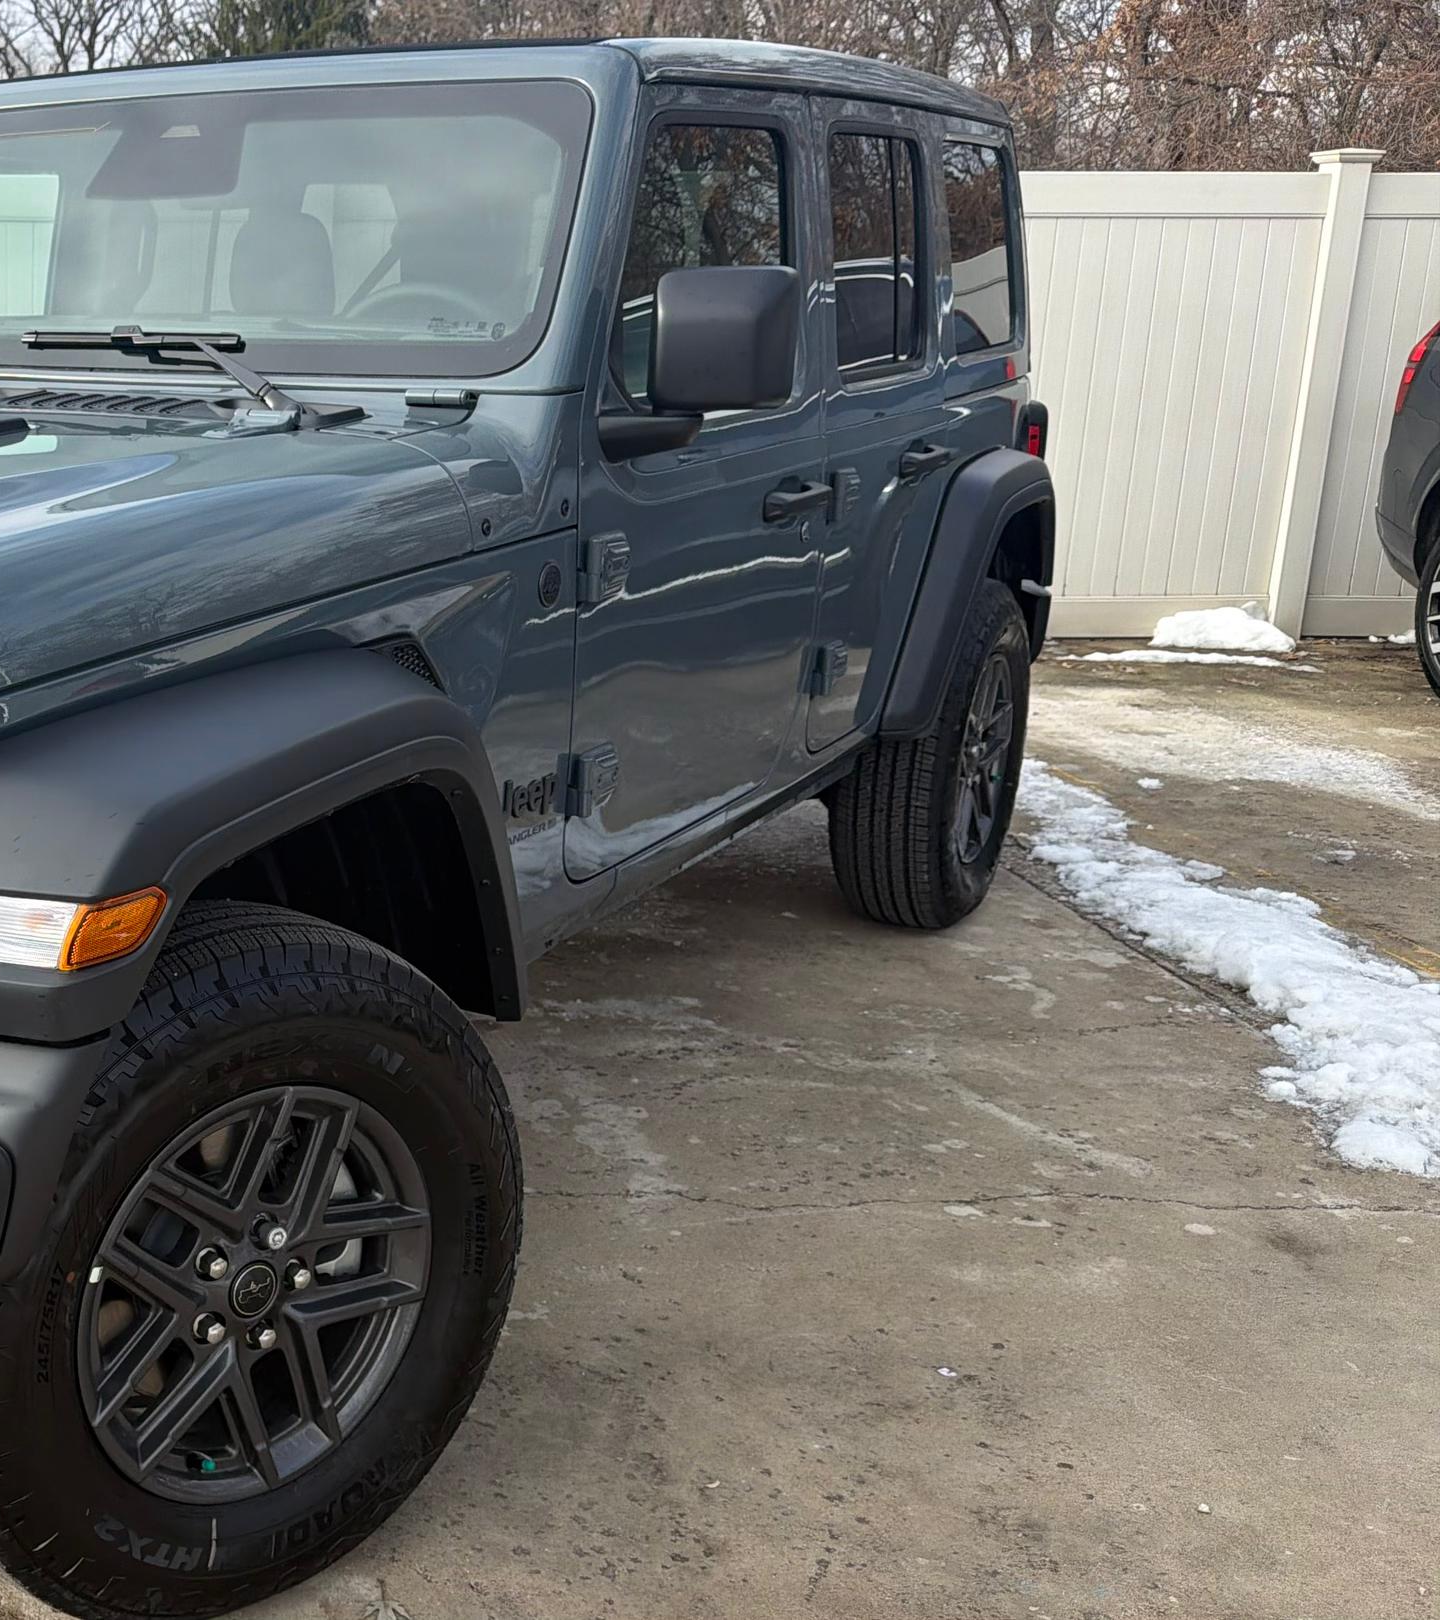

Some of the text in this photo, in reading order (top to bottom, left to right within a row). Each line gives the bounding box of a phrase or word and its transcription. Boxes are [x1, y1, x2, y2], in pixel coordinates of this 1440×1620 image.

[503, 773, 558, 818] Jeep
[468, 1163, 487, 1276] All Weather
[37, 1262, 64, 1384] 245/75R17
[94, 1512, 203, 1572] HTX2
